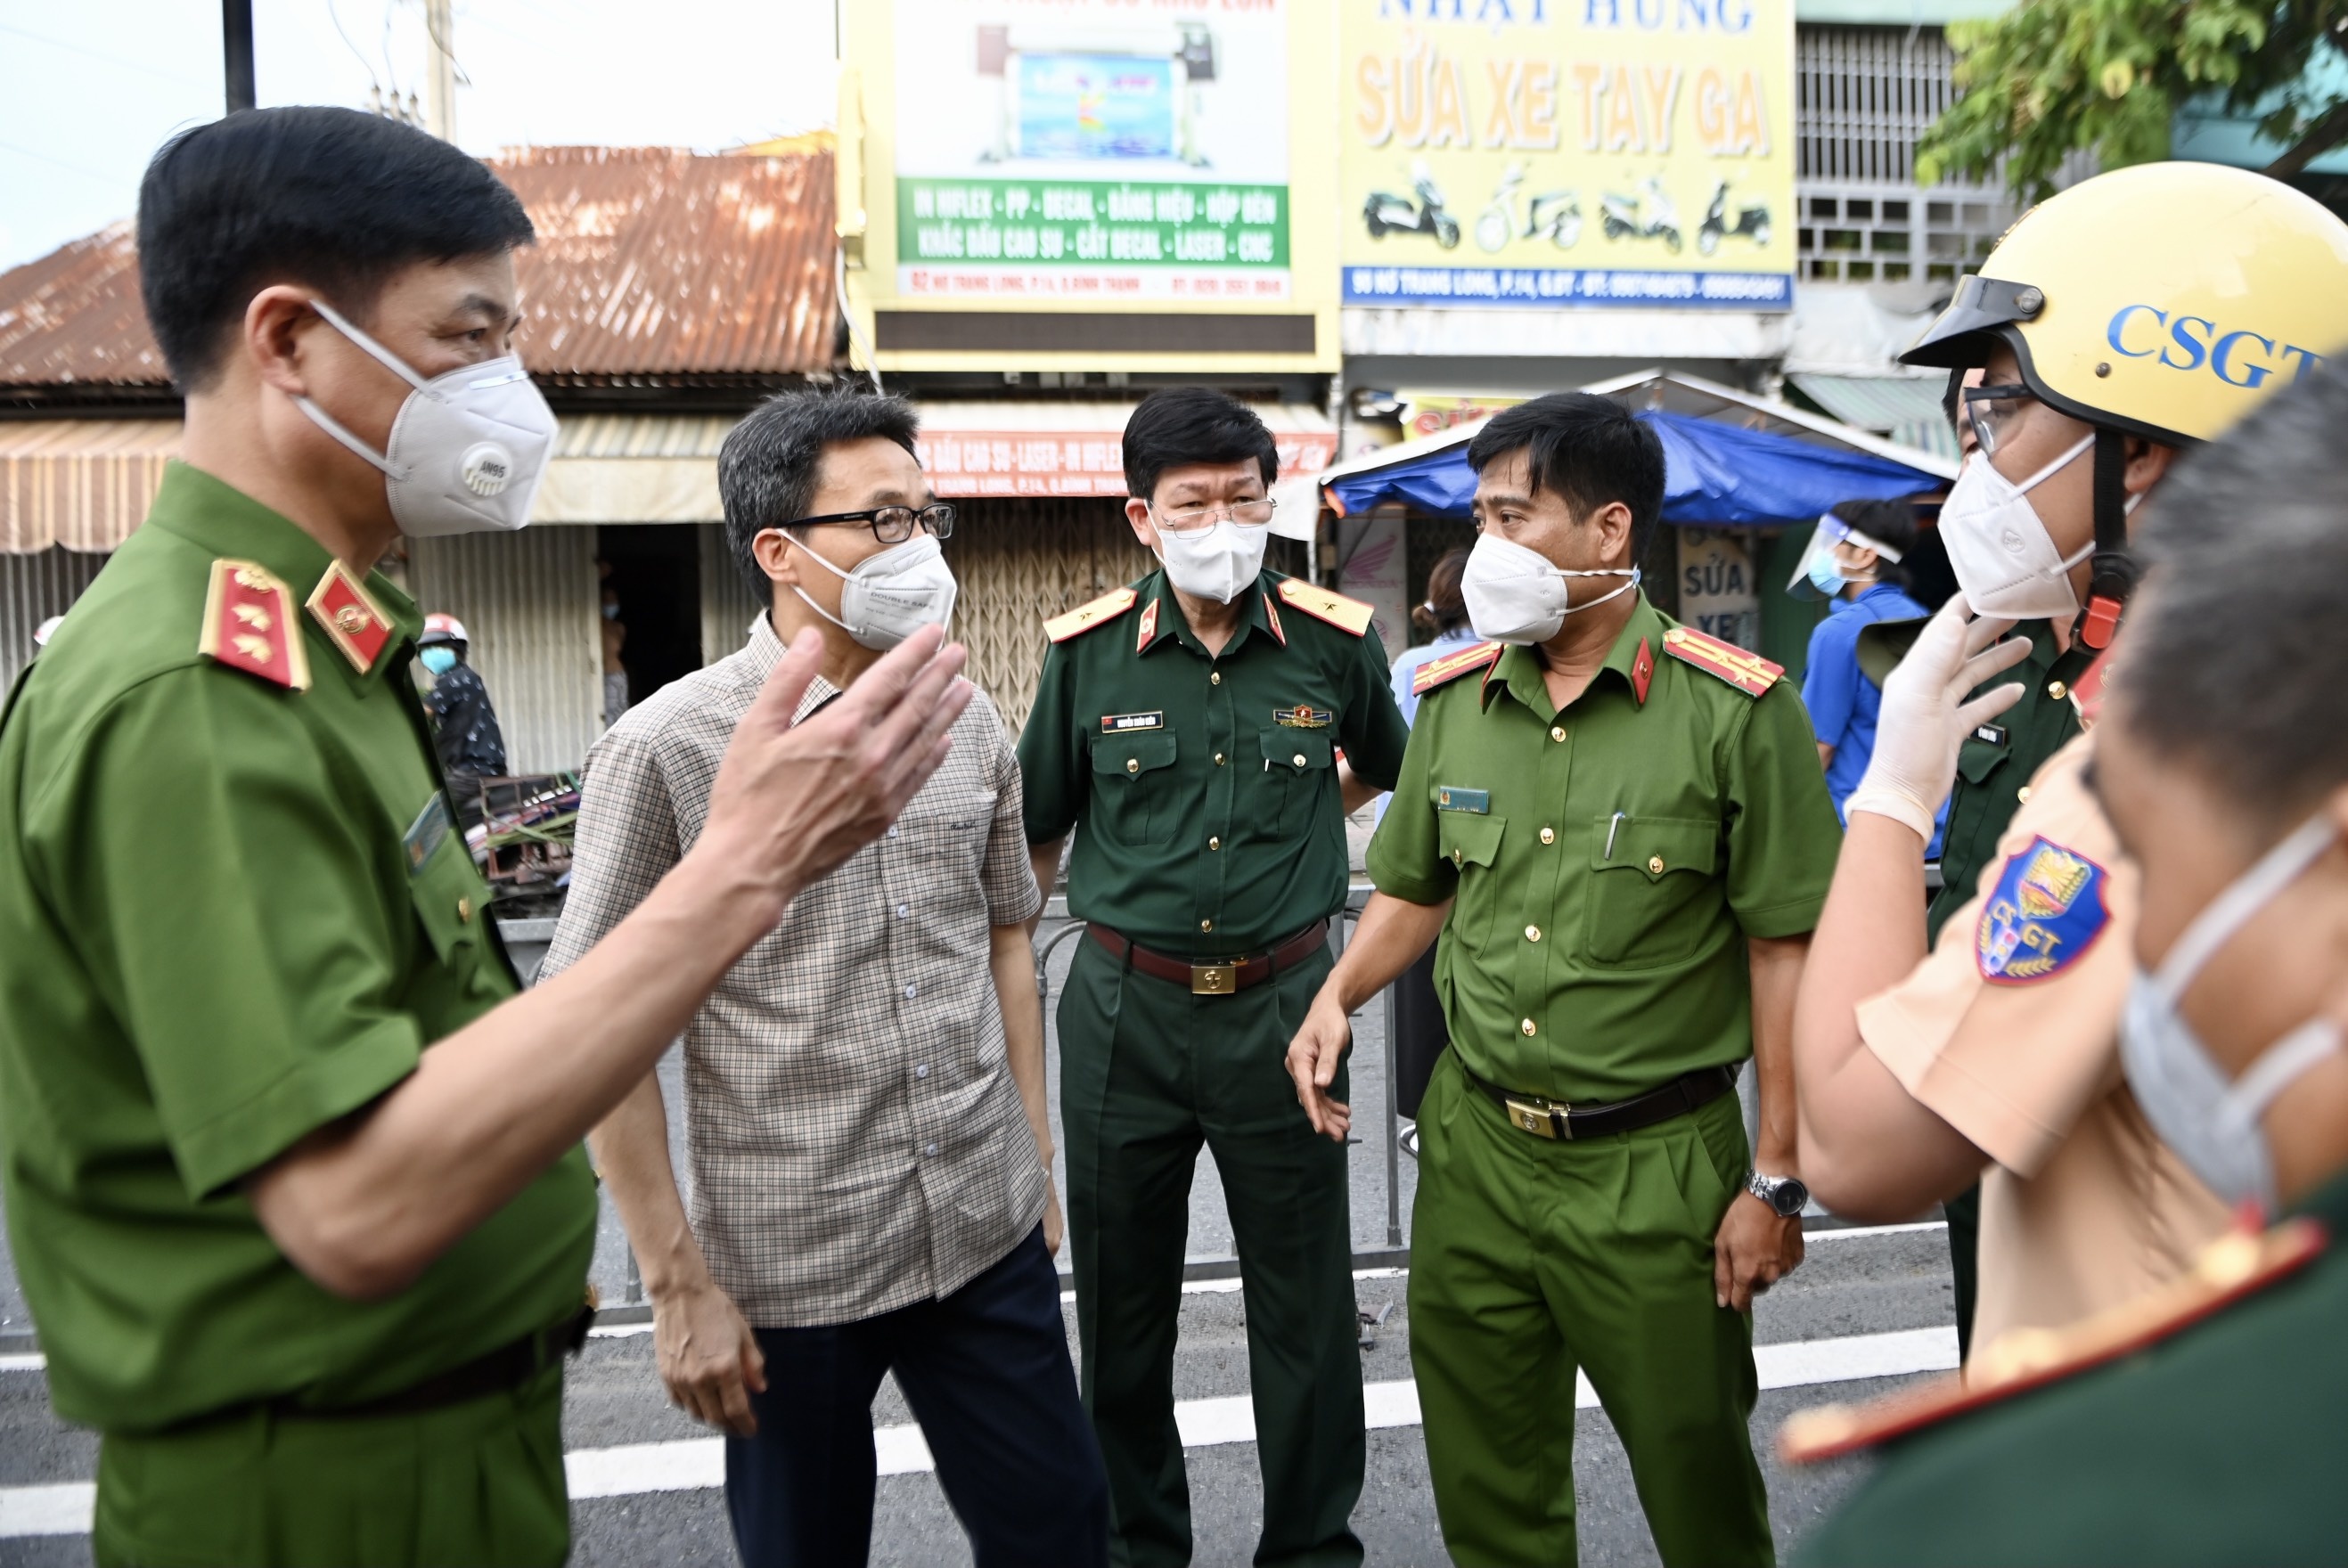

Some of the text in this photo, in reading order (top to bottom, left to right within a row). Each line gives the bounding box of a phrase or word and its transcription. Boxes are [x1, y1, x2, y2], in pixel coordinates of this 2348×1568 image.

[1356, 25, 1771, 158] SỬA XE TAY GA
[1005, 187, 1031, 220] PP
[1043, 187, 1096, 221] DECAL
[1003, 225, 1037, 258] CAO
[1039, 225, 1064, 259] SU
[1110, 226, 1164, 260] DECAL
[1174, 227, 1226, 261] LASER
[1238, 229, 1273, 262] CNC
[2107, 304, 2324, 389] CSGT
[479, 460, 506, 479] AN95
[1017, 440, 1059, 472] LASER
[1683, 552, 1743, 597] SỬA
[871, 592, 909, 604] DOUBLE
